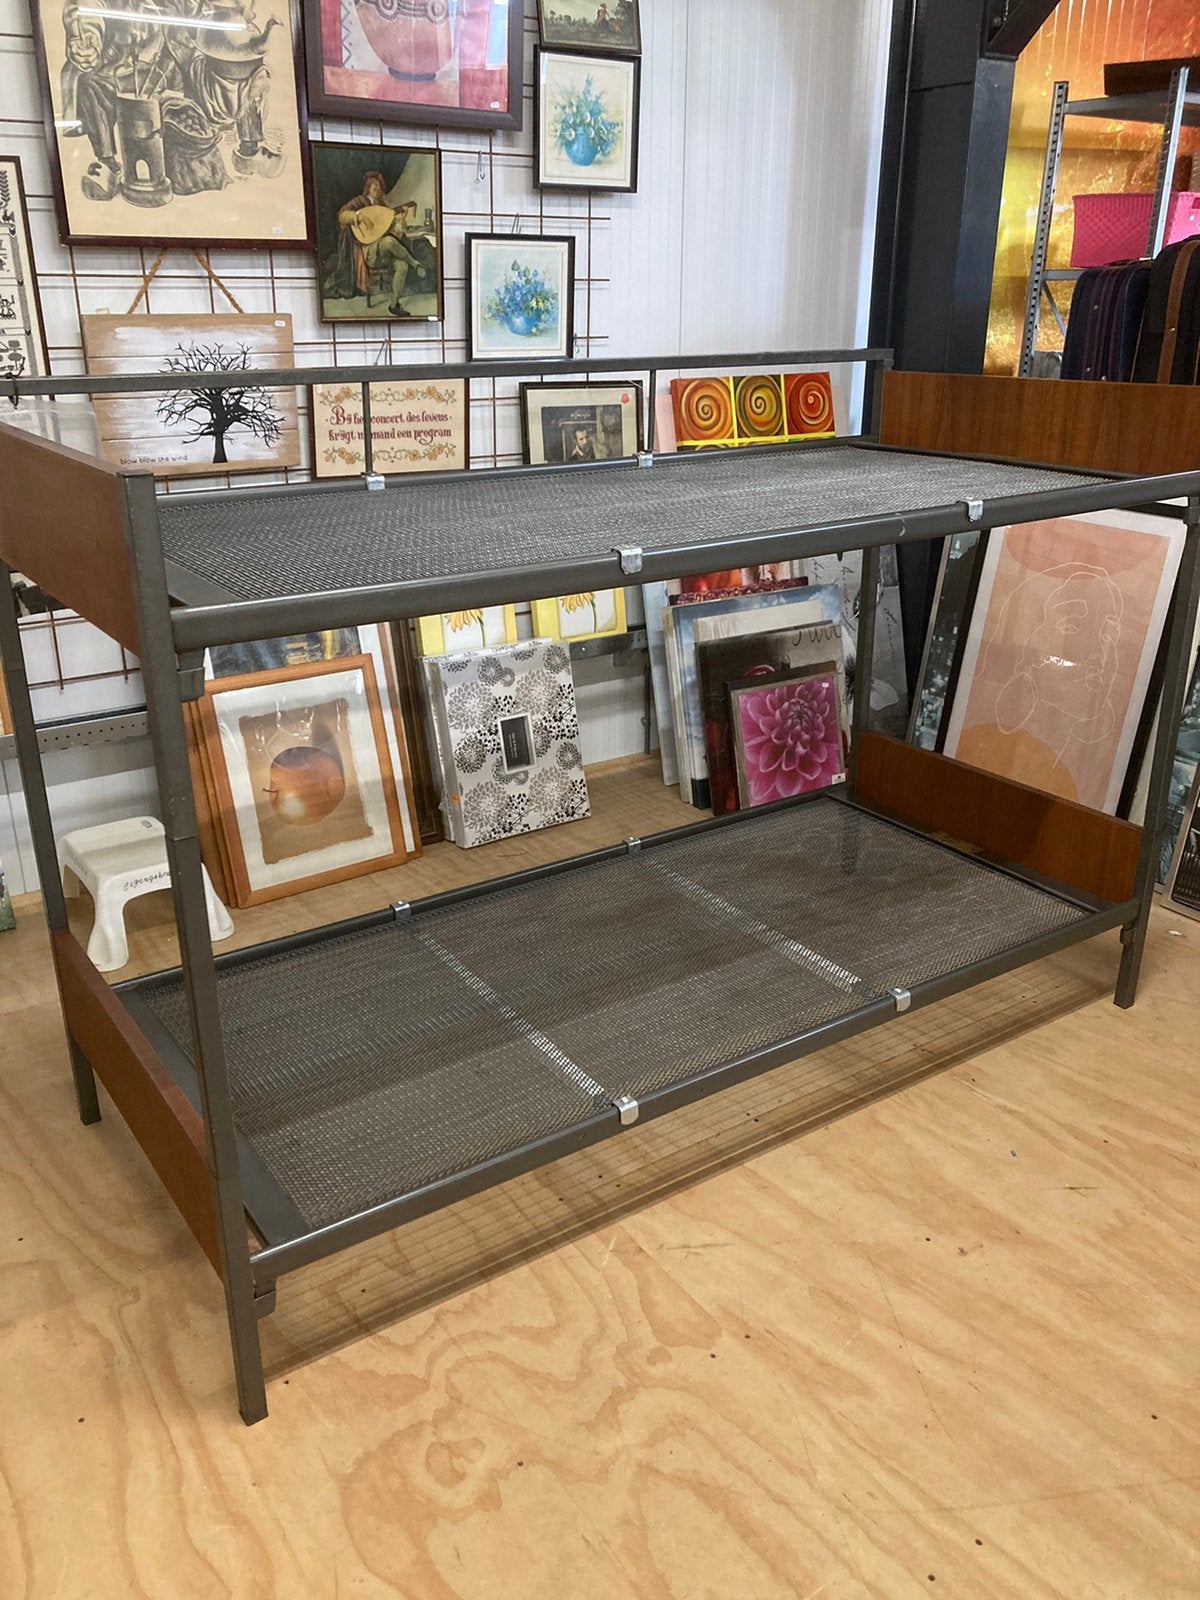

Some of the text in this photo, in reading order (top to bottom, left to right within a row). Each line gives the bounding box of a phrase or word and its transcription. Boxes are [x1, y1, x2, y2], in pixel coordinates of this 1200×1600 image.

[370, 413, 405, 425] concert
[406, 411, 421, 422] des
[421, 410, 449, 422] levens
[357, 428, 396, 440] nmand
[396, 430, 412, 439] een
[413, 429, 452, 445] program
[120, 457, 137, 465] blow
[139, 455, 156, 464] blow
